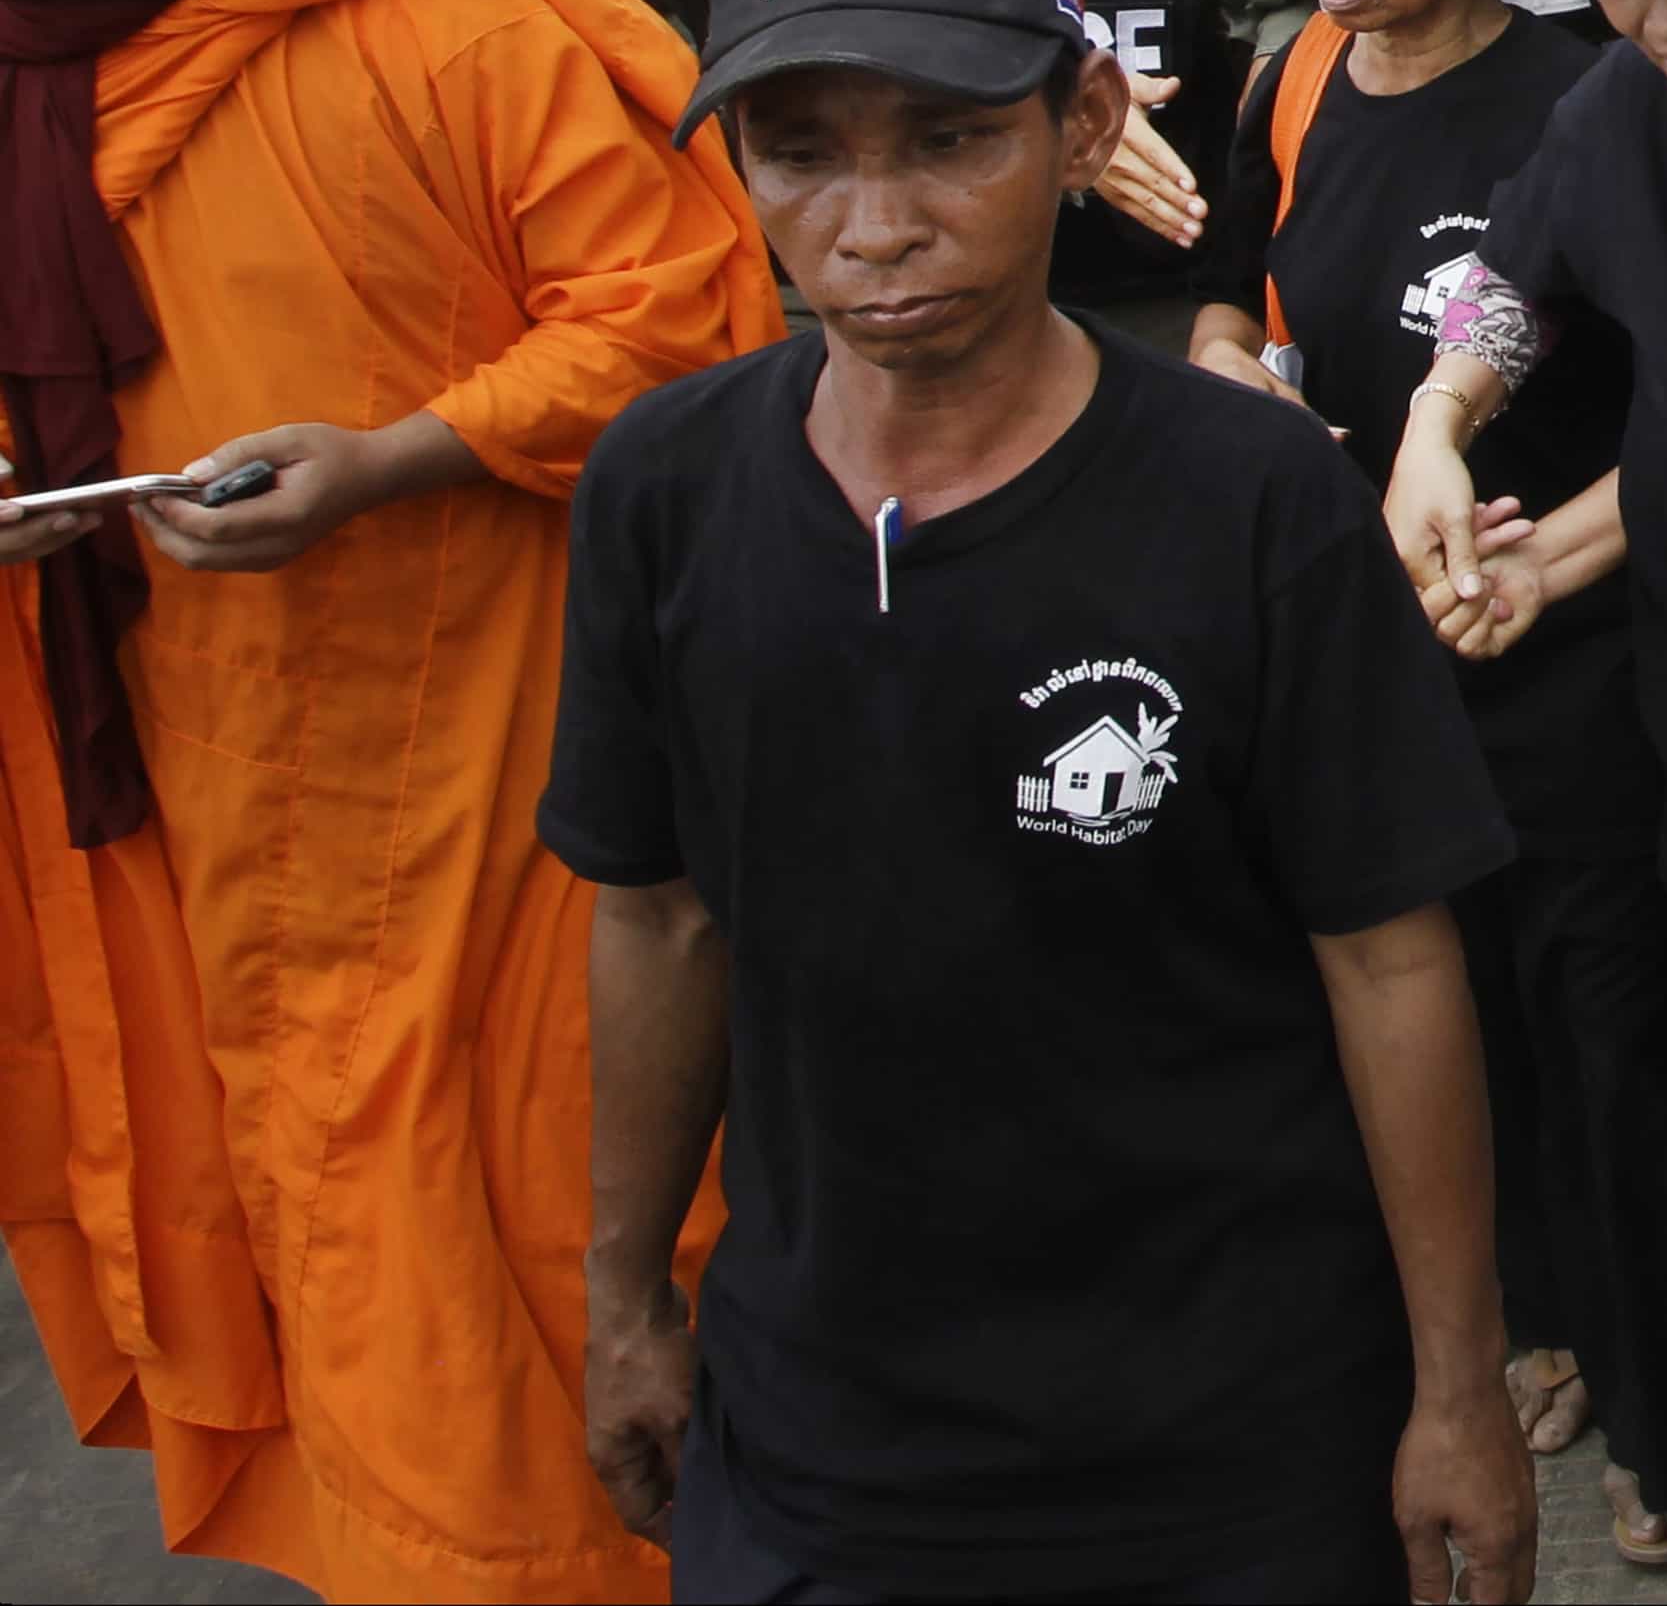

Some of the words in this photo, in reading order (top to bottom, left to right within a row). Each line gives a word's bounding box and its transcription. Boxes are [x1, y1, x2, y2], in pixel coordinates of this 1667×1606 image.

[1016, 815, 1067, 834] World
[1070, 824, 1127, 845] Habitat
[1126, 817, 1153, 837] Day
